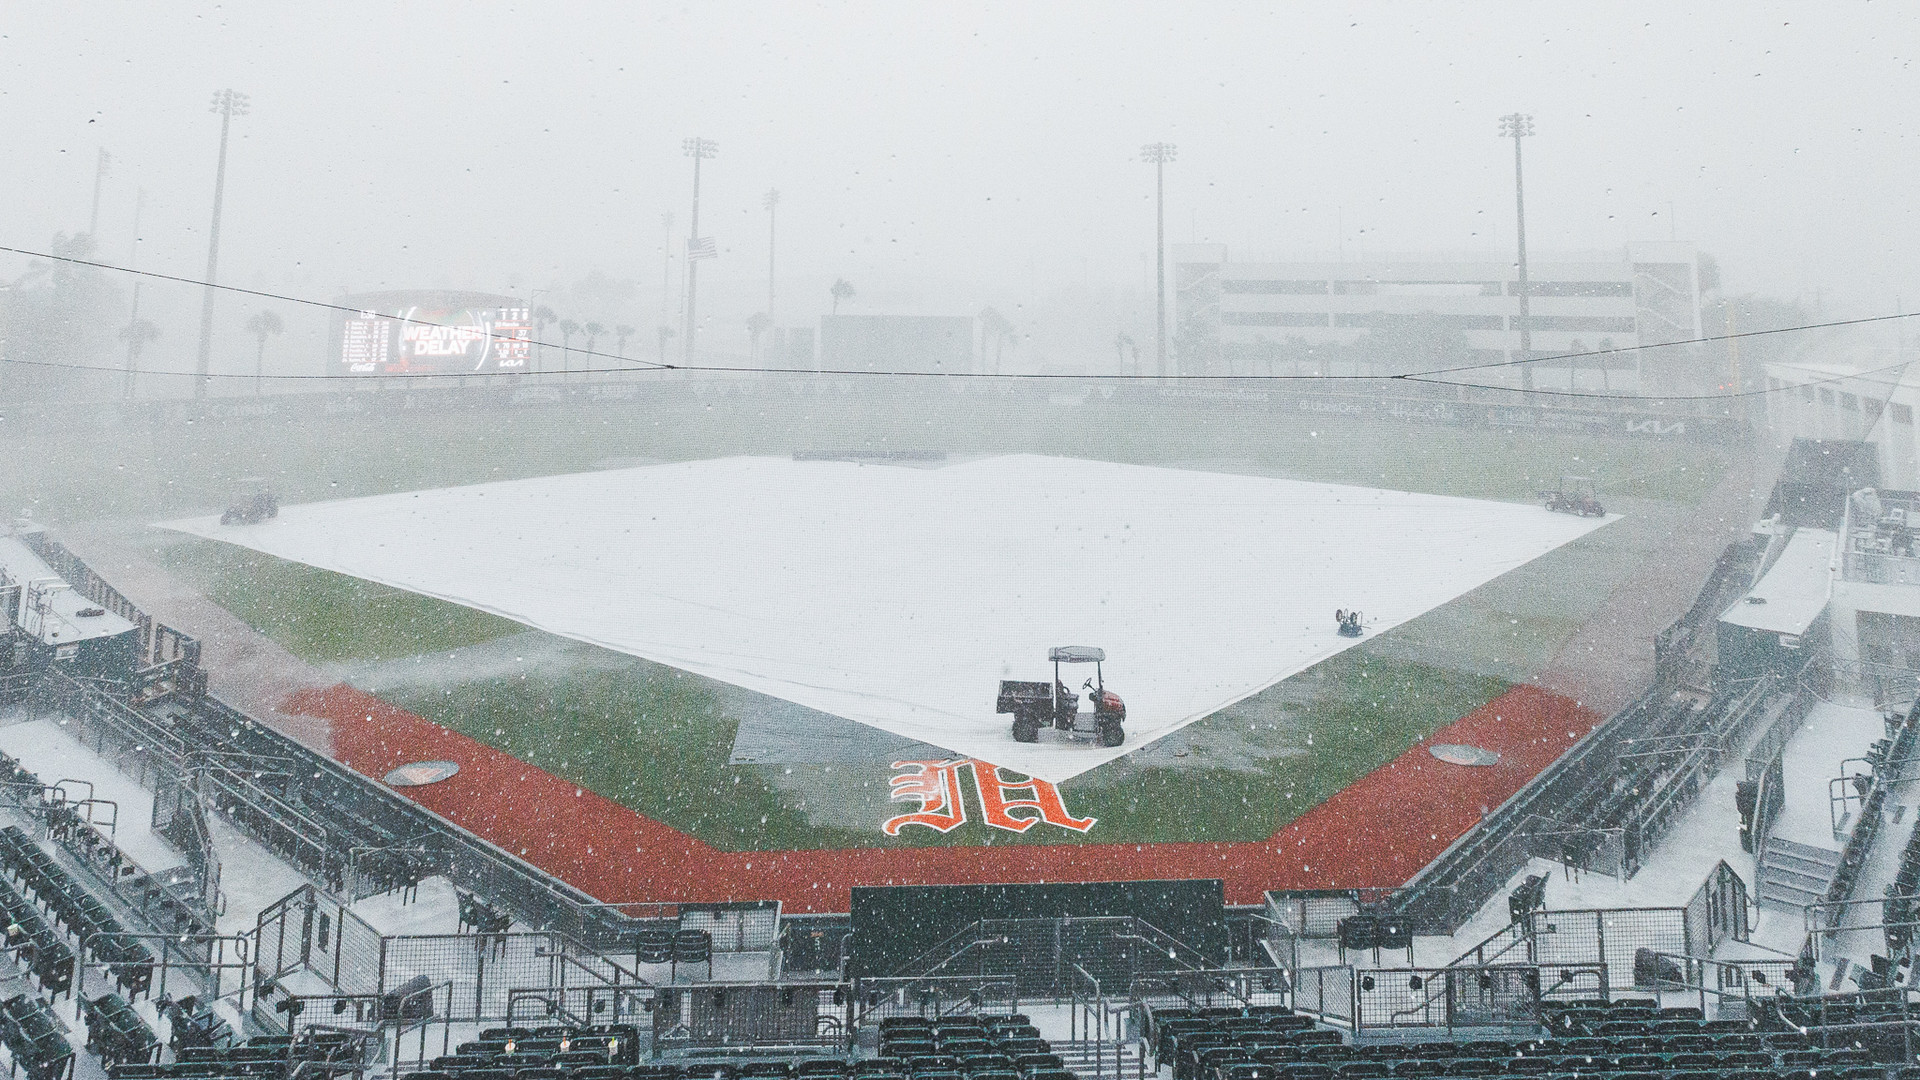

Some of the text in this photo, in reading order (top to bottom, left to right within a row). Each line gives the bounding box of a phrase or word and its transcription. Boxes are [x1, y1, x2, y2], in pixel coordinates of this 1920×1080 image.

[403, 326, 484, 341] WEATHER
[415, 340, 470, 355] DELAY
[499, 359, 524, 367] KIA
[1626, 419, 1685, 434] KIA
